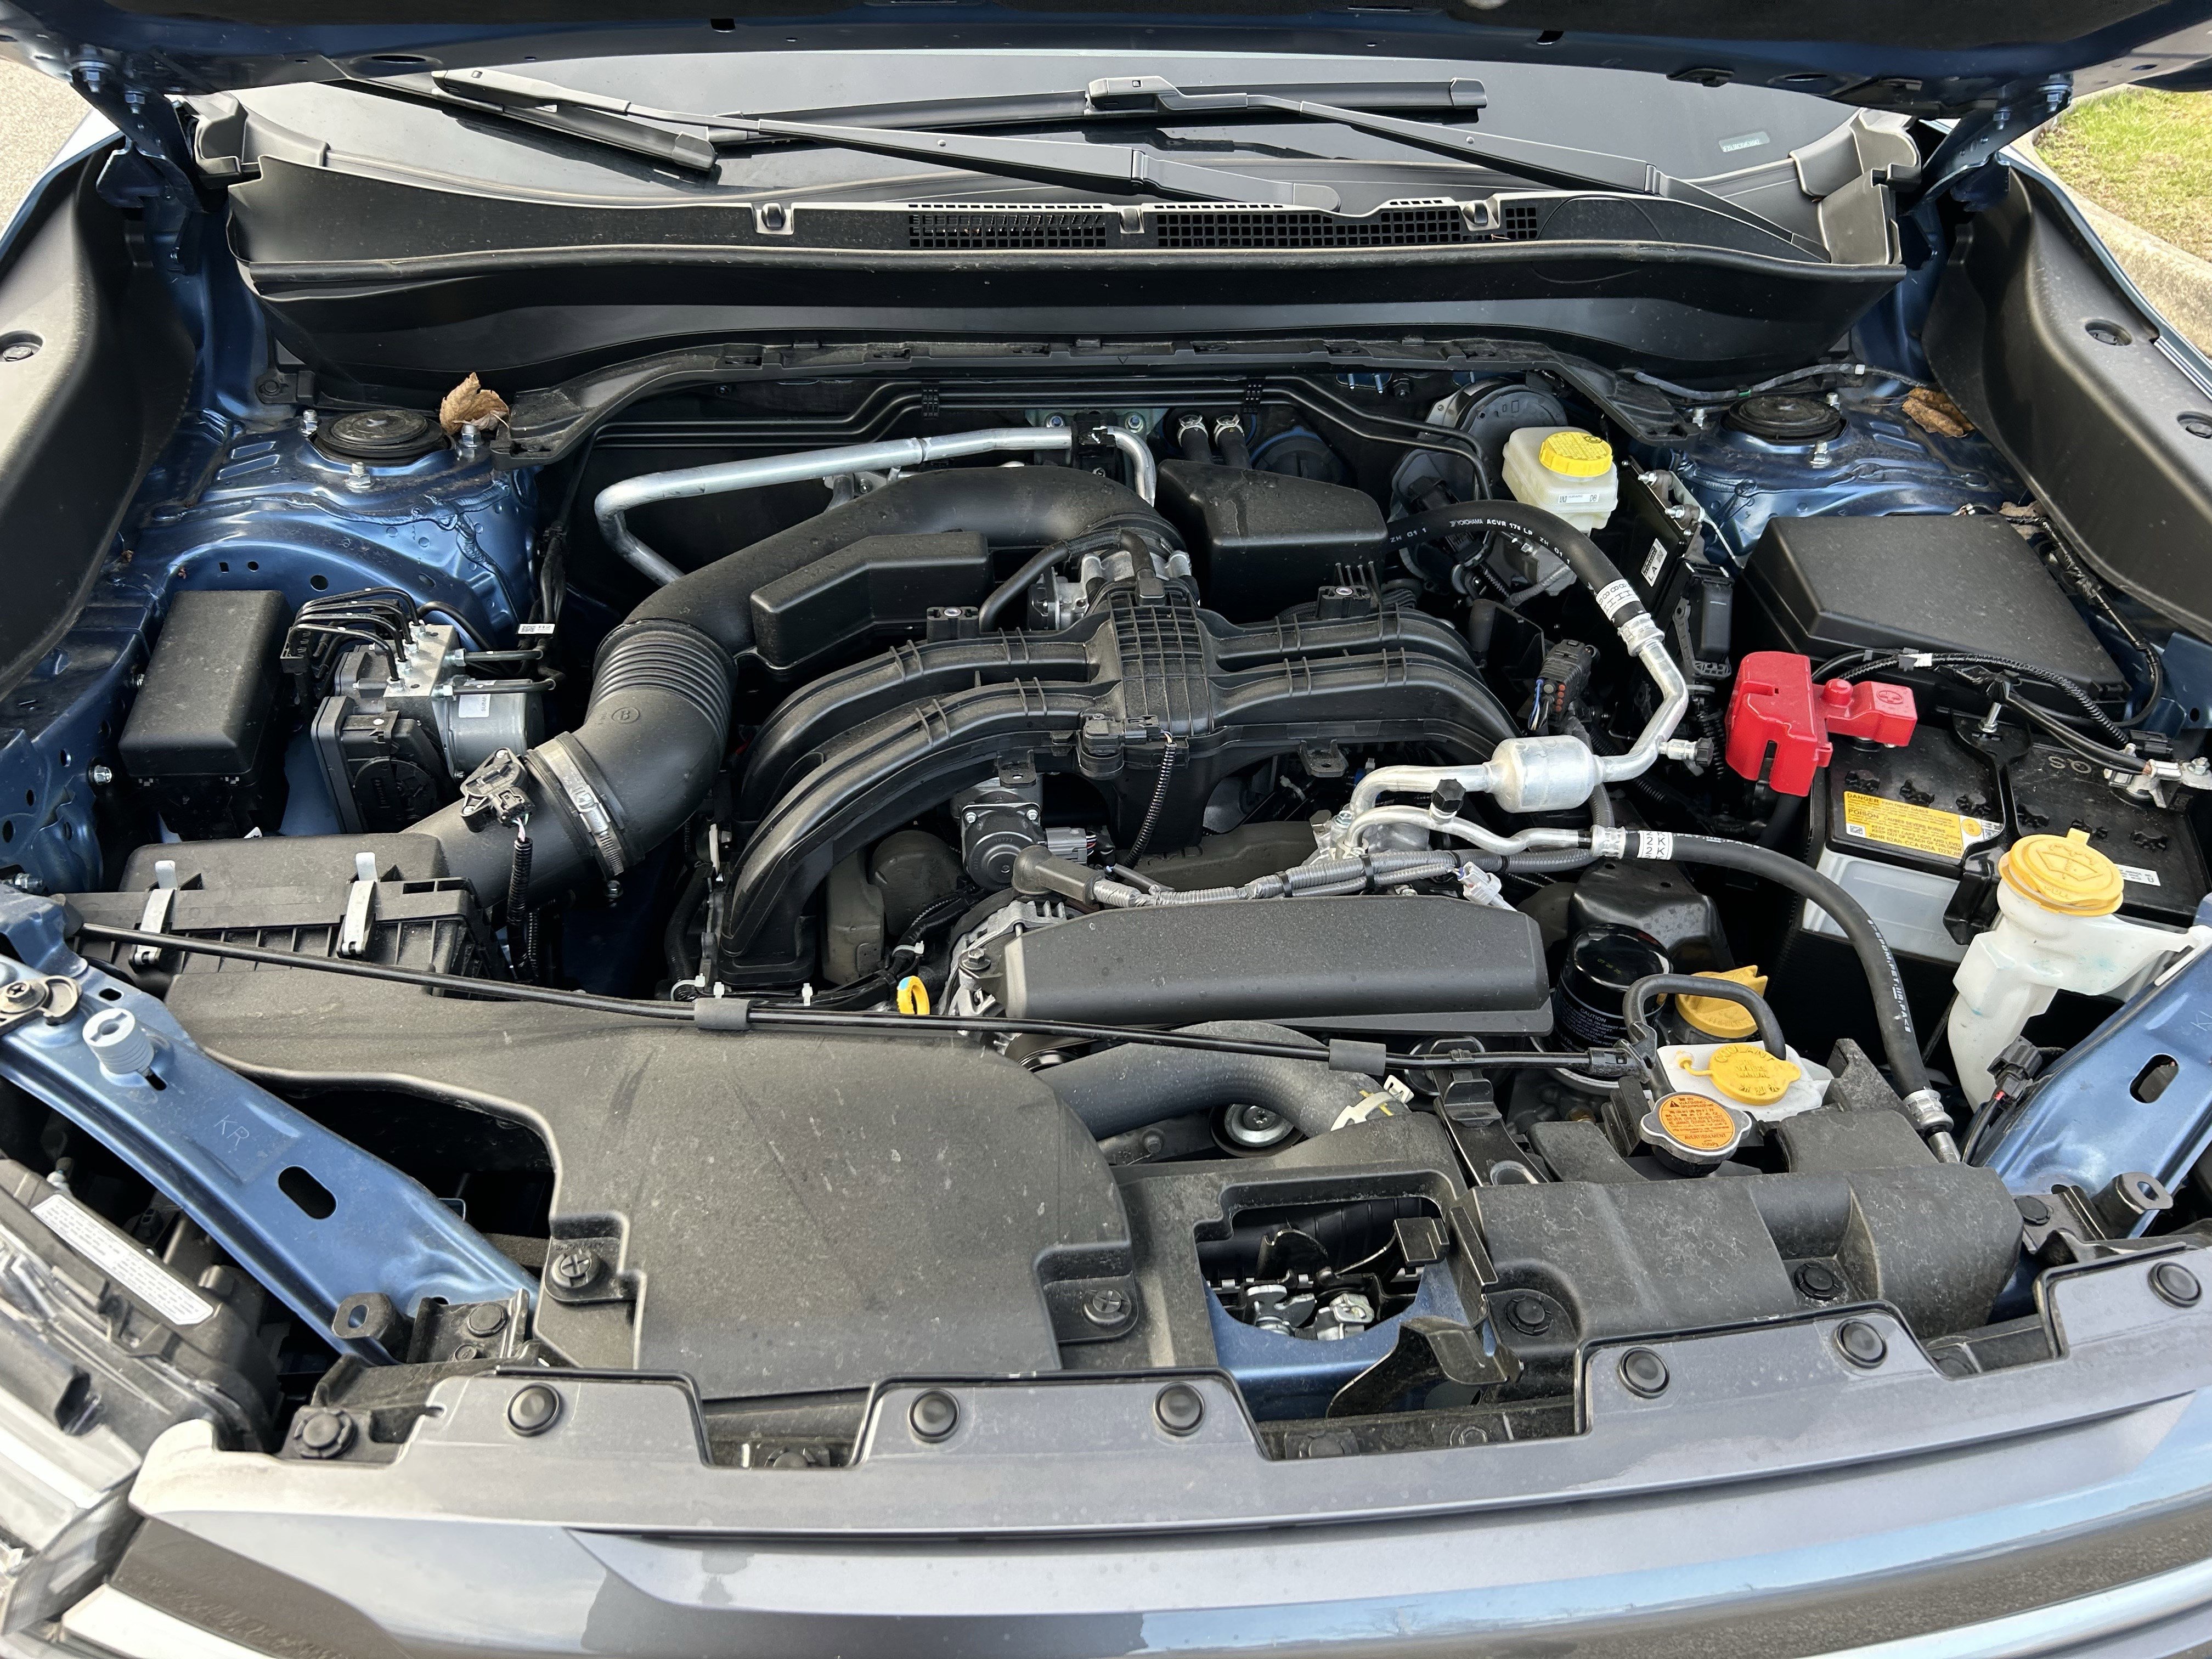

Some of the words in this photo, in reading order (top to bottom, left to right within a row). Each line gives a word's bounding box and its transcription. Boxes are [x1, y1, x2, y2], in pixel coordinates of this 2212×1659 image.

[1847, 793, 1878, 804] DANGER
[1848, 808, 1878, 819] POISON
[1646, 837, 1652, 845] 2
[1657, 837, 1666, 845] K
[1580, 1008, 1606, 1023] CAUTION
[1714, 1045, 1775, 1063] COOLANT
[213, 1114, 250, 1147] KR
